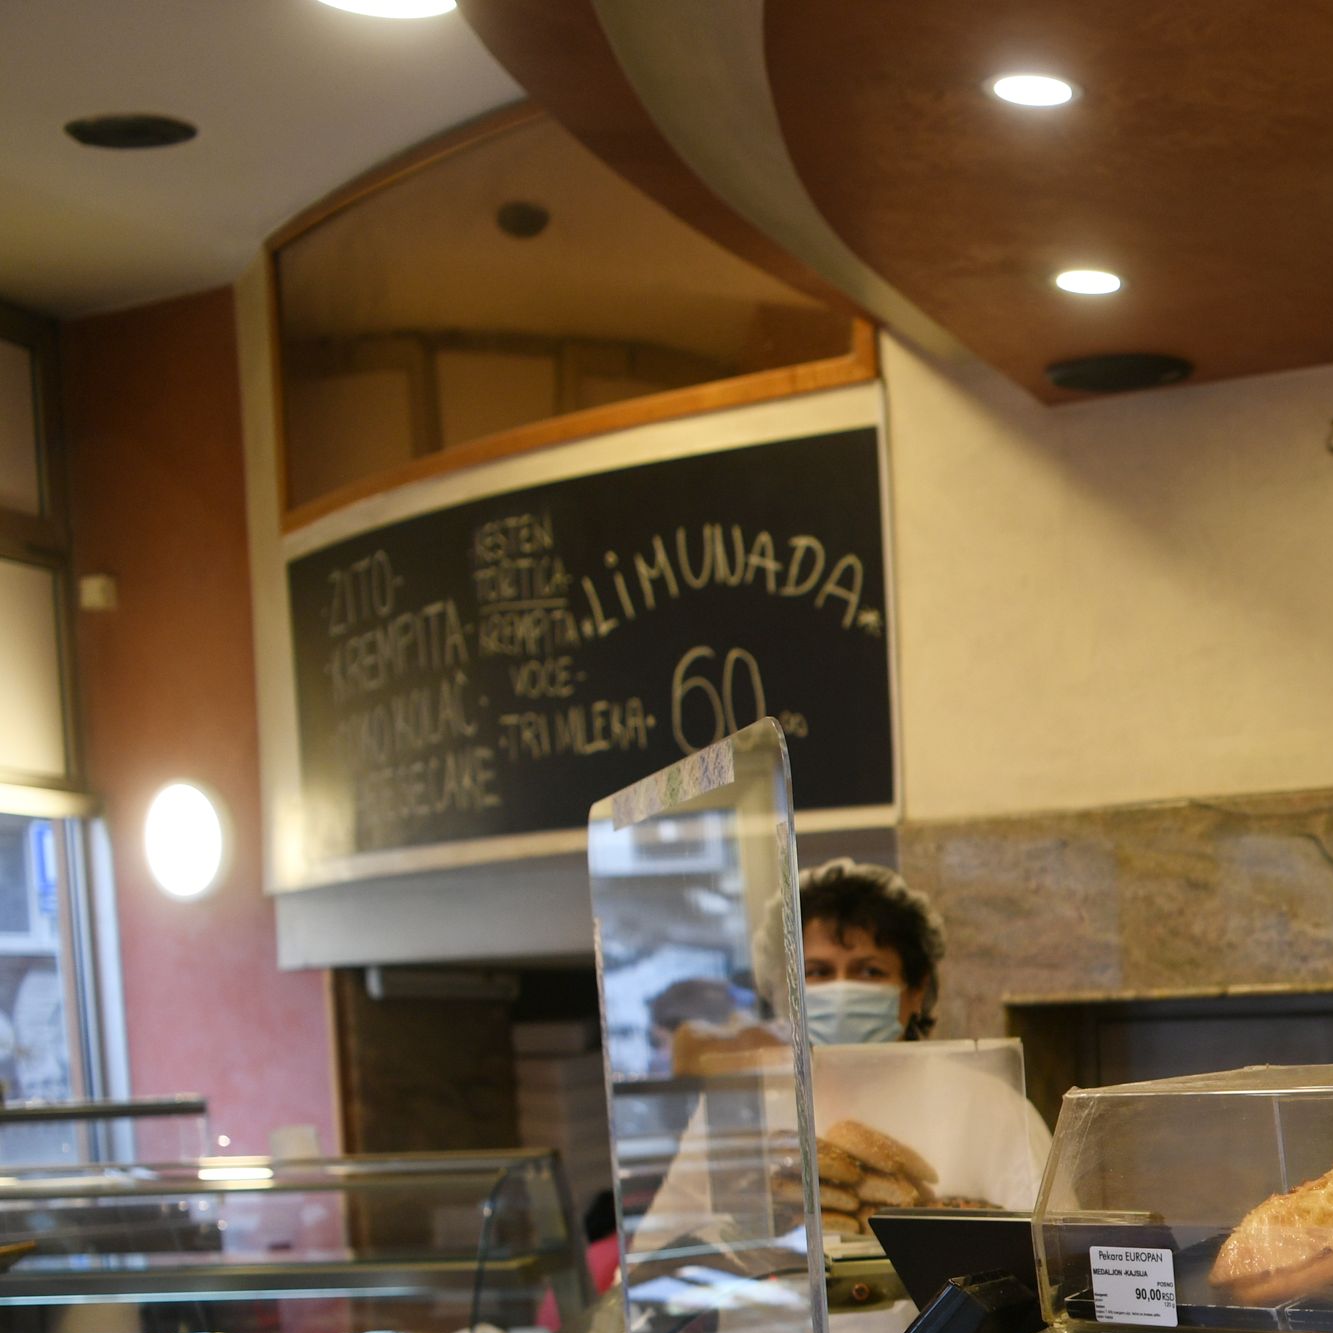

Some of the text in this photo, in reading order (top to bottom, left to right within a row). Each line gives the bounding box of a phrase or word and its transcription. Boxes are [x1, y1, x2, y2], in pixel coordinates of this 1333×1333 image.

[1098, 1251, 1162, 1262] Pekara EUROPAN
[1093, 1268, 1122, 1276] MEDALJON
